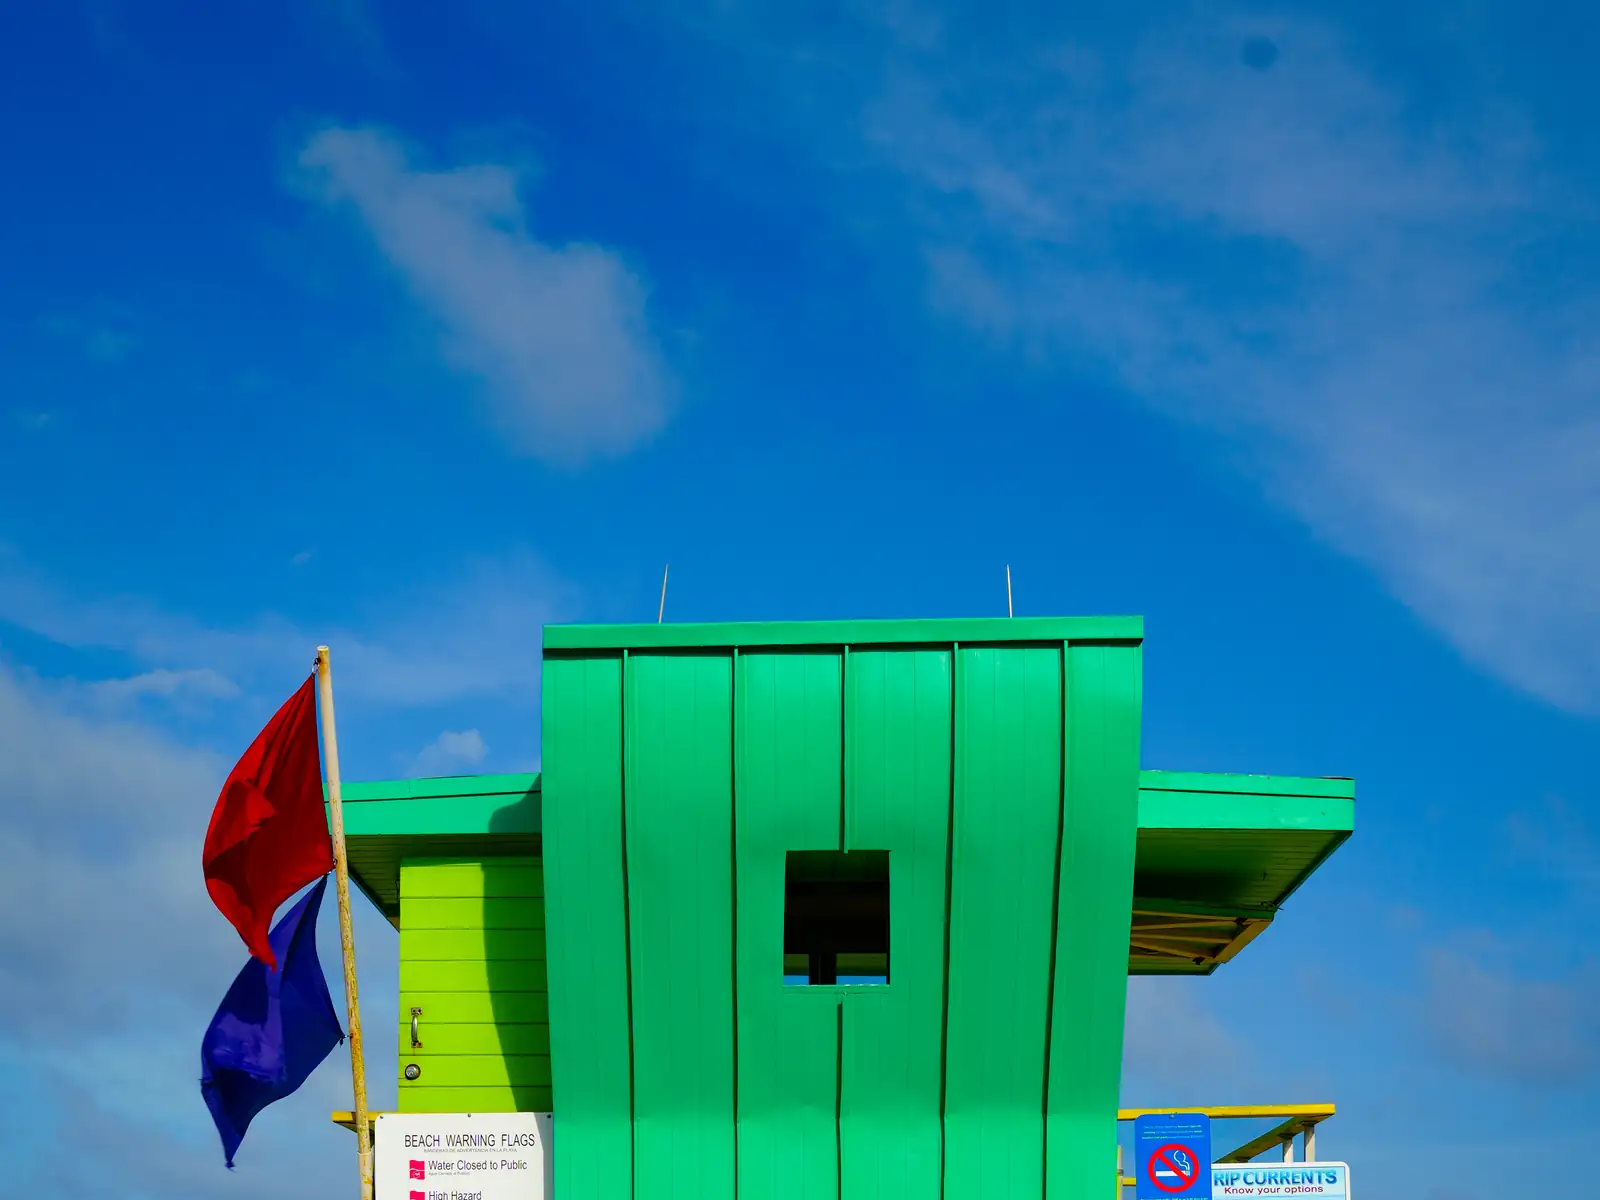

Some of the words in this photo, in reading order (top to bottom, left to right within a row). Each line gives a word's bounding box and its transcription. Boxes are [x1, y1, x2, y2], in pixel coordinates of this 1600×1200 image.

[404, 1134, 440, 1148] BEACH
[446, 1134, 496, 1148] WARNING
[502, 1133, 536, 1147] FLAGS
[428, 1160, 454, 1170] Water
[457, 1160, 487, 1170] Closed
[490, 1160, 498, 1170] to
[500, 1160, 528, 1170] Public
[1214, 1171, 1240, 1186] RIP
[1243, 1170, 1337, 1185] CURRENTS
[1285, 1186, 1323, 1194] options
[451, 1191, 482, 1200] Hazard
